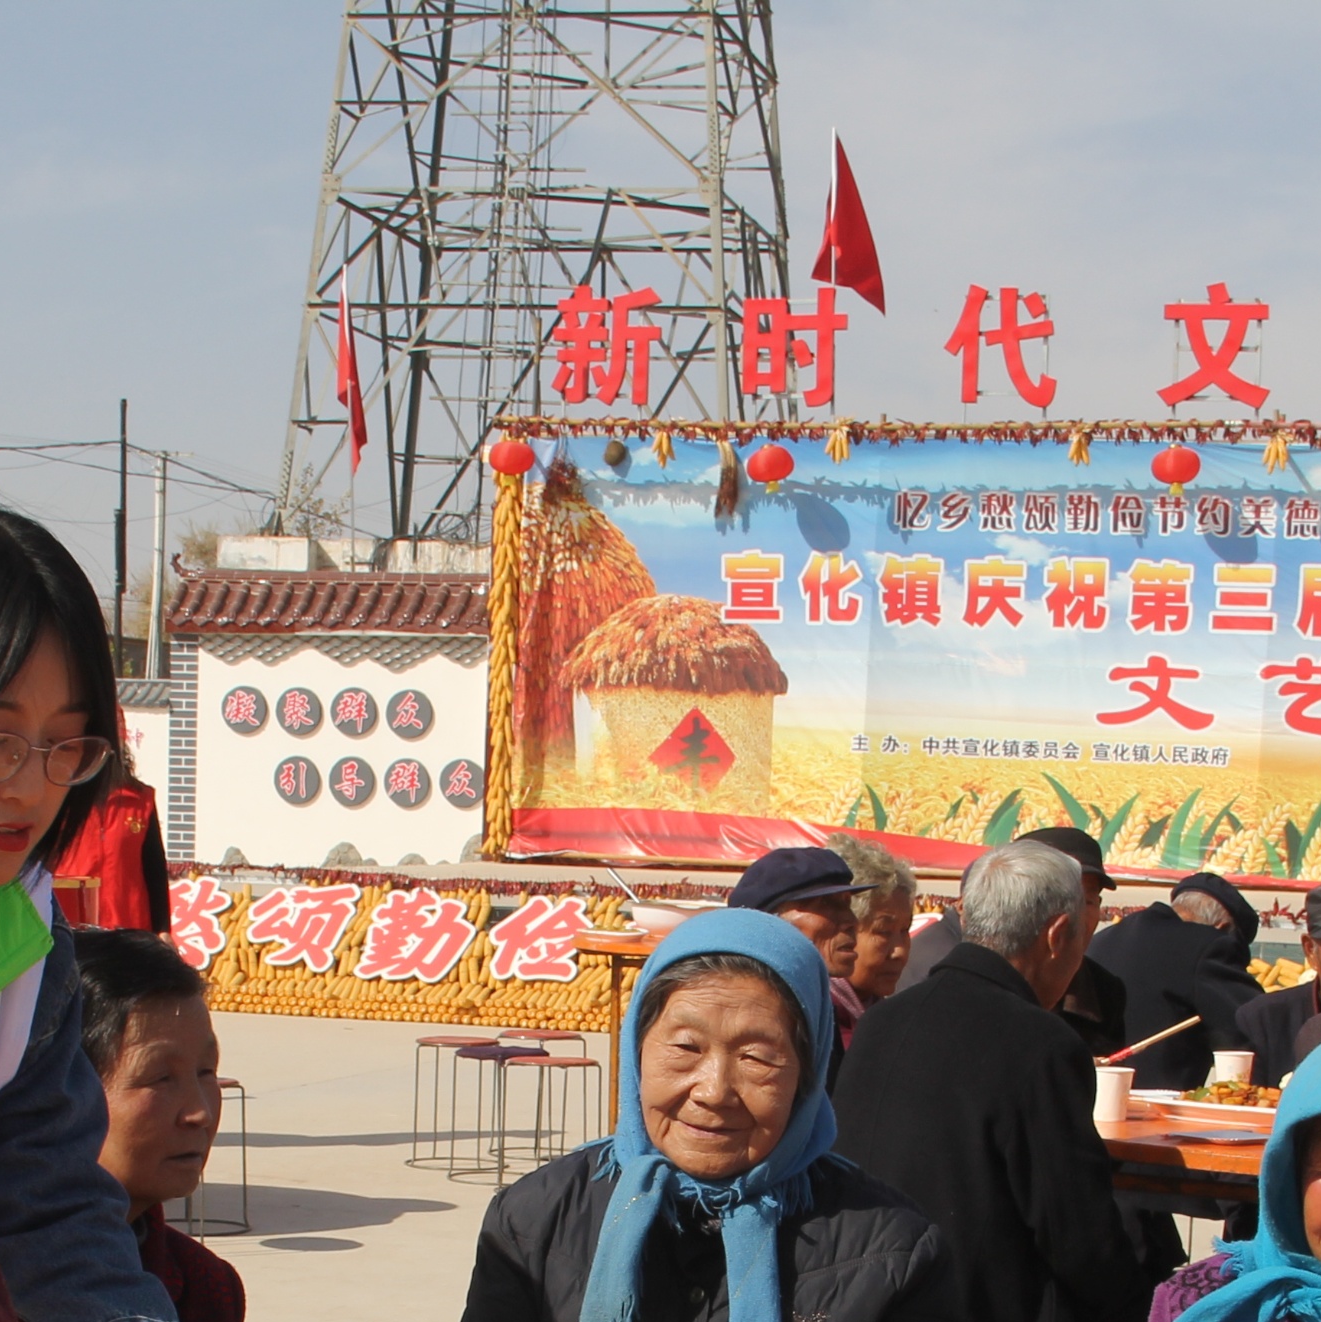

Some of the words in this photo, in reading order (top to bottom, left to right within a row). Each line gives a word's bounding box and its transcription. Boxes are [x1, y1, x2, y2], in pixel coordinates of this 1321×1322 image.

[895, 491, 1321, 539] 忆乡愁颂勤俭节约美德
[224, 692, 423, 731] 凝聚群众
[921, 736, 1080, 760] 中共宣化镇委员会
[1091, 743, 1230, 766] 宣化镇人民政府
[278, 760, 476, 803] 引导群众
